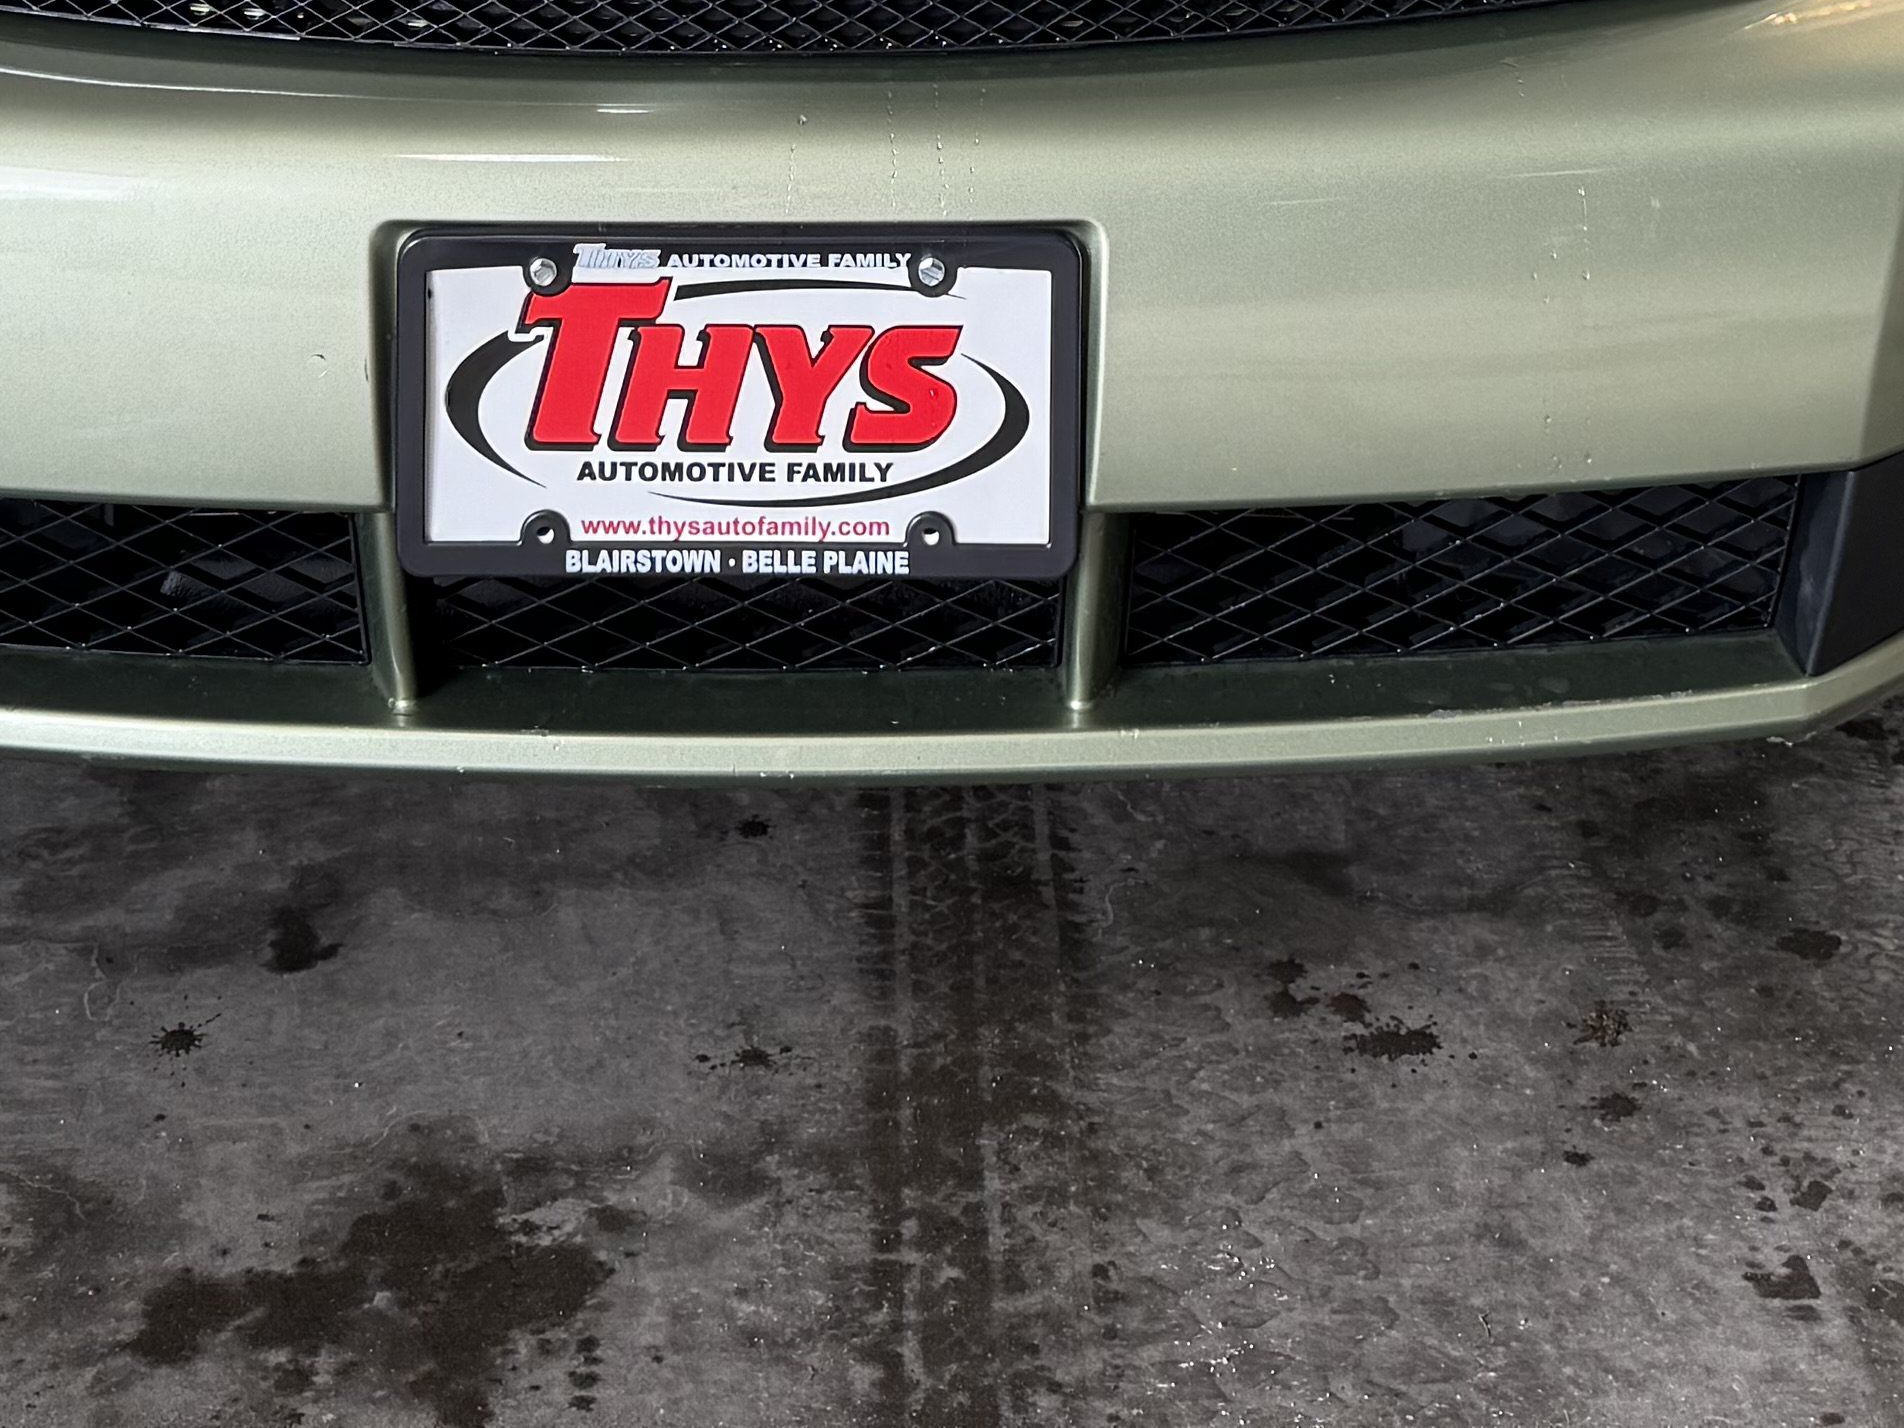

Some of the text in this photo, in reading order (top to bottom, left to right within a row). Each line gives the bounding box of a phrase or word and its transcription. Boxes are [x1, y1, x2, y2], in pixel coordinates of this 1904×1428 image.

[666, 254, 821, 269] AUTOMOTIVE
[823, 253, 912, 269] FAMILY
[515, 276, 964, 452] THYS
[576, 461, 895, 484] AUTOMOTIVE FAMILY
[580, 514, 891, 542] www.thysautofamily.com
[565, 549, 910, 575] BLAIRSTOWN BELLE PLAINE
